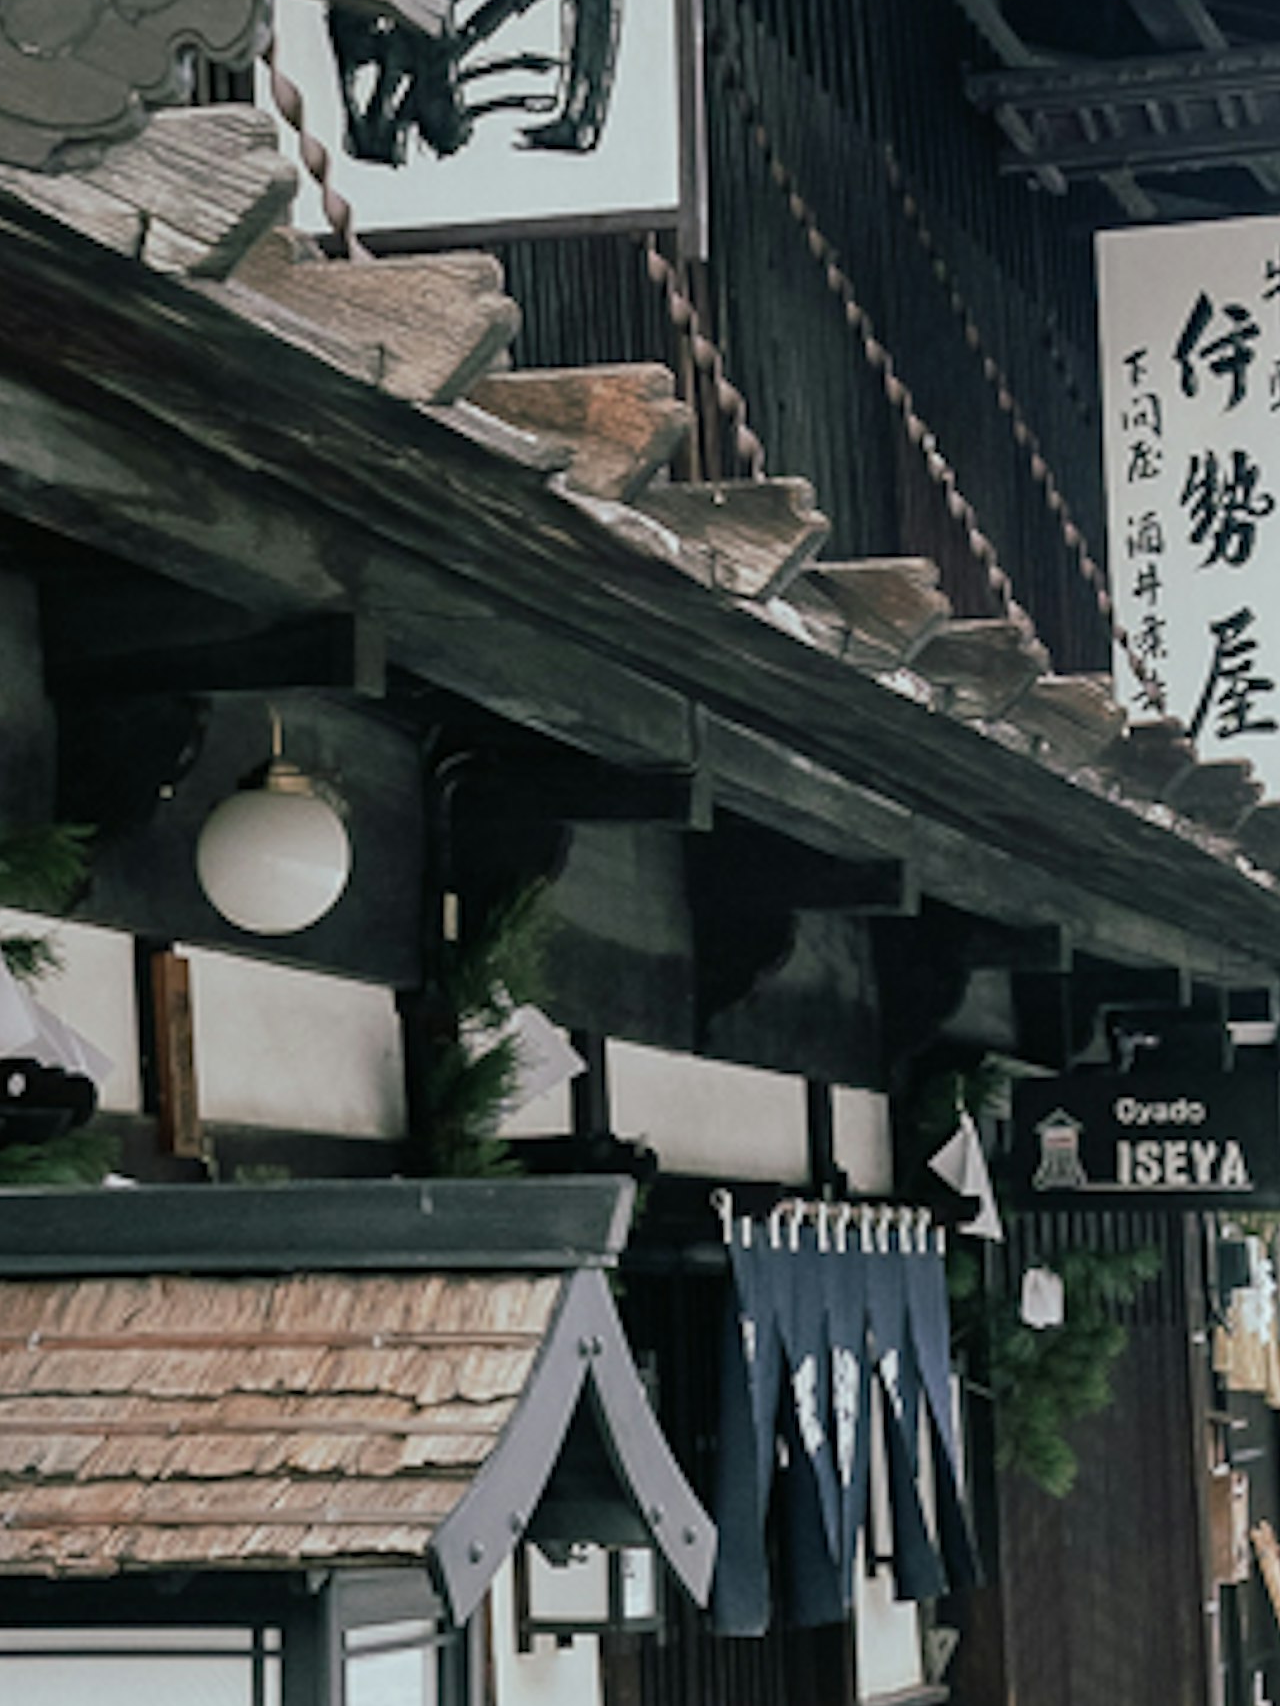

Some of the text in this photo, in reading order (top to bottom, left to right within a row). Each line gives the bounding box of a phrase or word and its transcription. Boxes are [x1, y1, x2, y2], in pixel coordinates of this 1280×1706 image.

[1172, 288, 1280, 740] 伊勢屋
[1116, 1097, 1207, 1125] Oyado
[1117, 1139, 1248, 1185] ISEYA
